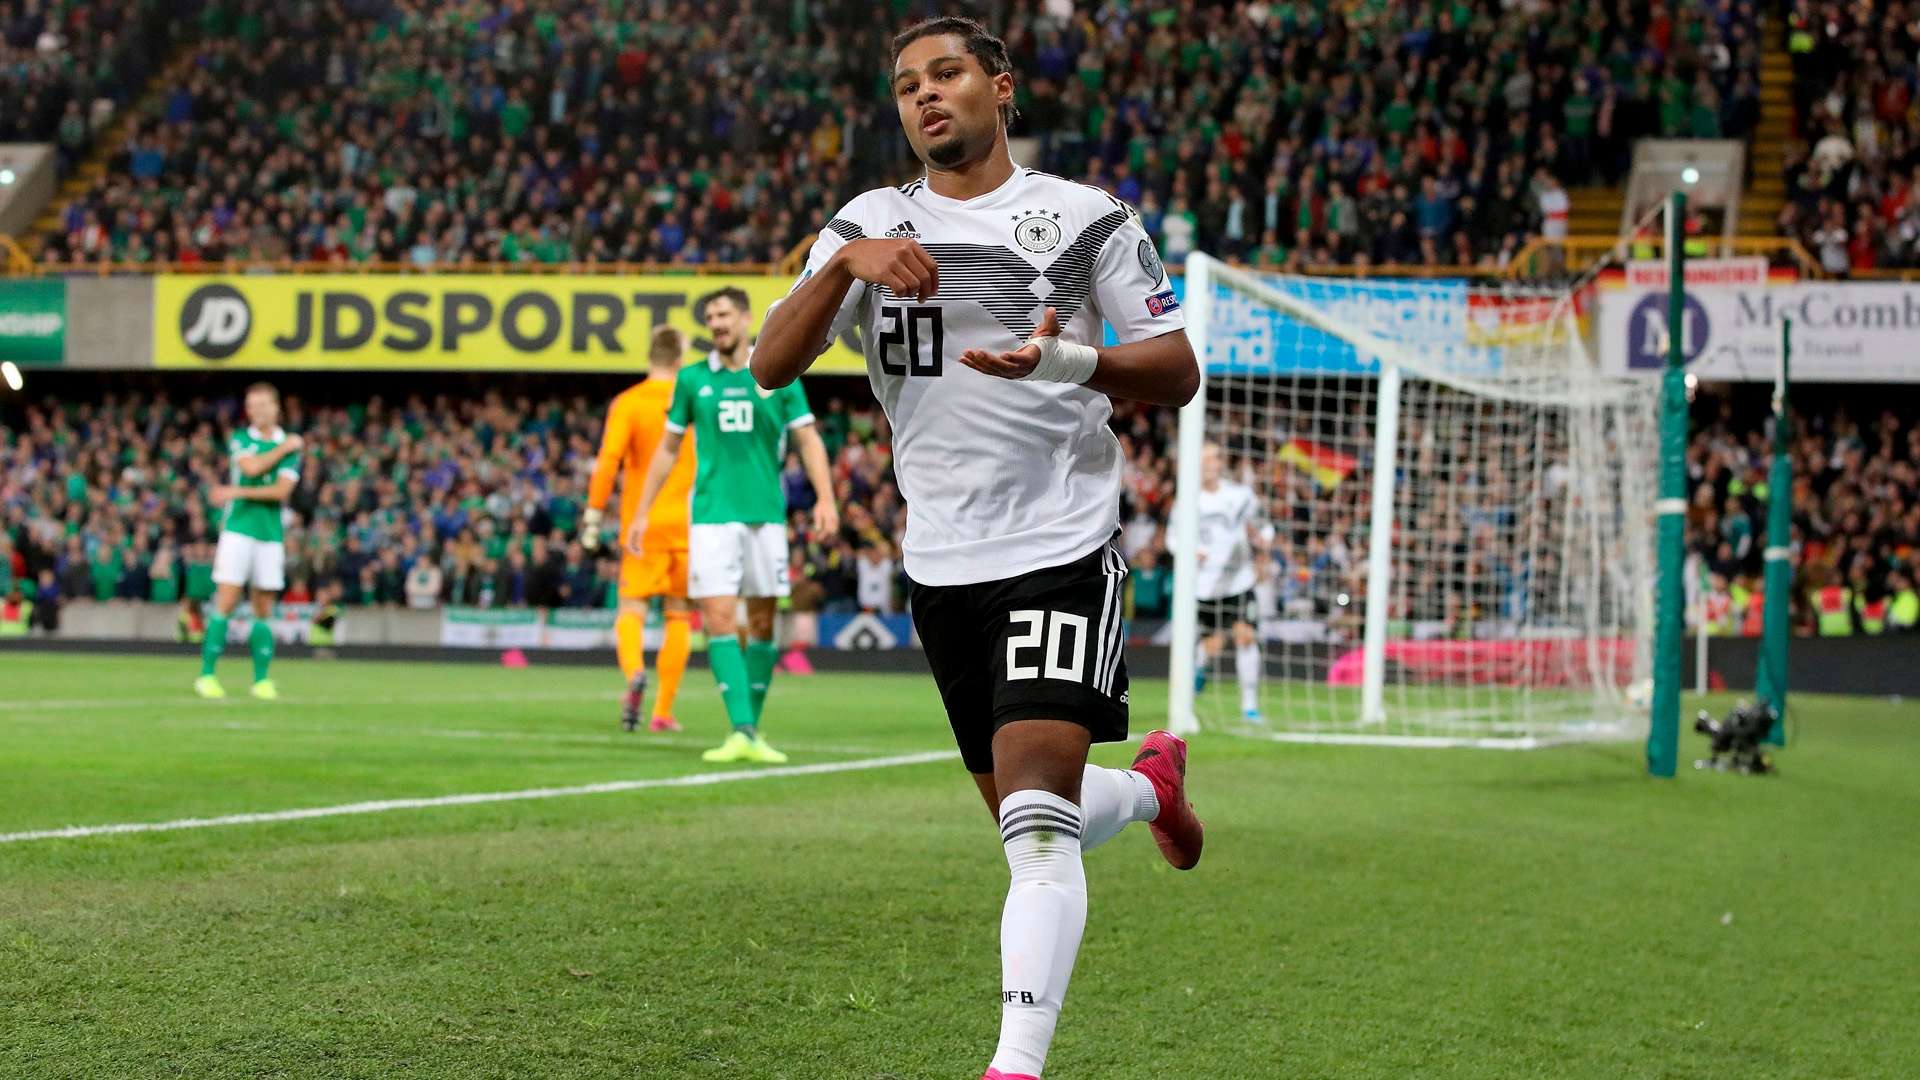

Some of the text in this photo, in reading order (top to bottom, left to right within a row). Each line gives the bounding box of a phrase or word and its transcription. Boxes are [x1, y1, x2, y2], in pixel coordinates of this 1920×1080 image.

[885, 231, 921, 239] adidas
[1161, 295, 1178, 308] RES
[185, 297, 249, 345] JD
[879, 306, 943, 377] 20
[718, 400, 753, 432] 20
[1006, 609, 1088, 684] 20
[1002, 990, 1034, 1004] DFB
